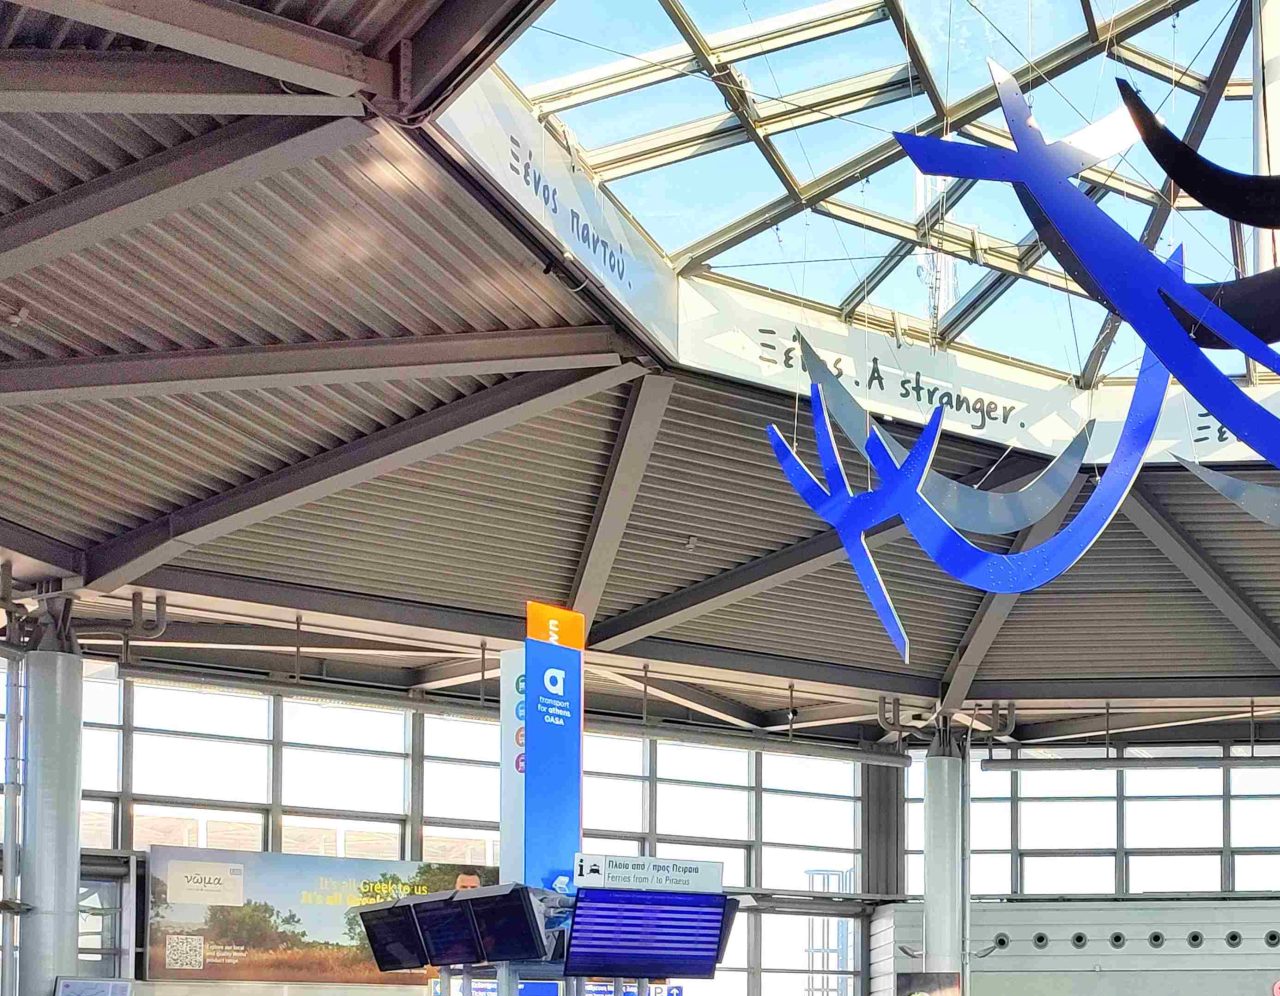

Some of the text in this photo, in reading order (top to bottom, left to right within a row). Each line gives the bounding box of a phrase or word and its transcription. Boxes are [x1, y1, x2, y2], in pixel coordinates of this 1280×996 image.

[509, 134, 558, 214] Ξένος
[899, 371, 1026, 430] stranger.
[539, 696, 570, 708] transport
[537, 704, 571, 717] for athens
[544, 715, 565, 726] OASA
[607, 873, 631, 882] Ferries
[632, 873, 649, 884] from
[656, 875, 663, 884] to
[665, 875, 690, 885] Piraeus
[360, 880, 395, 893] Greek
[399, 883, 410, 894] to
[414, 885, 428, 895] us
